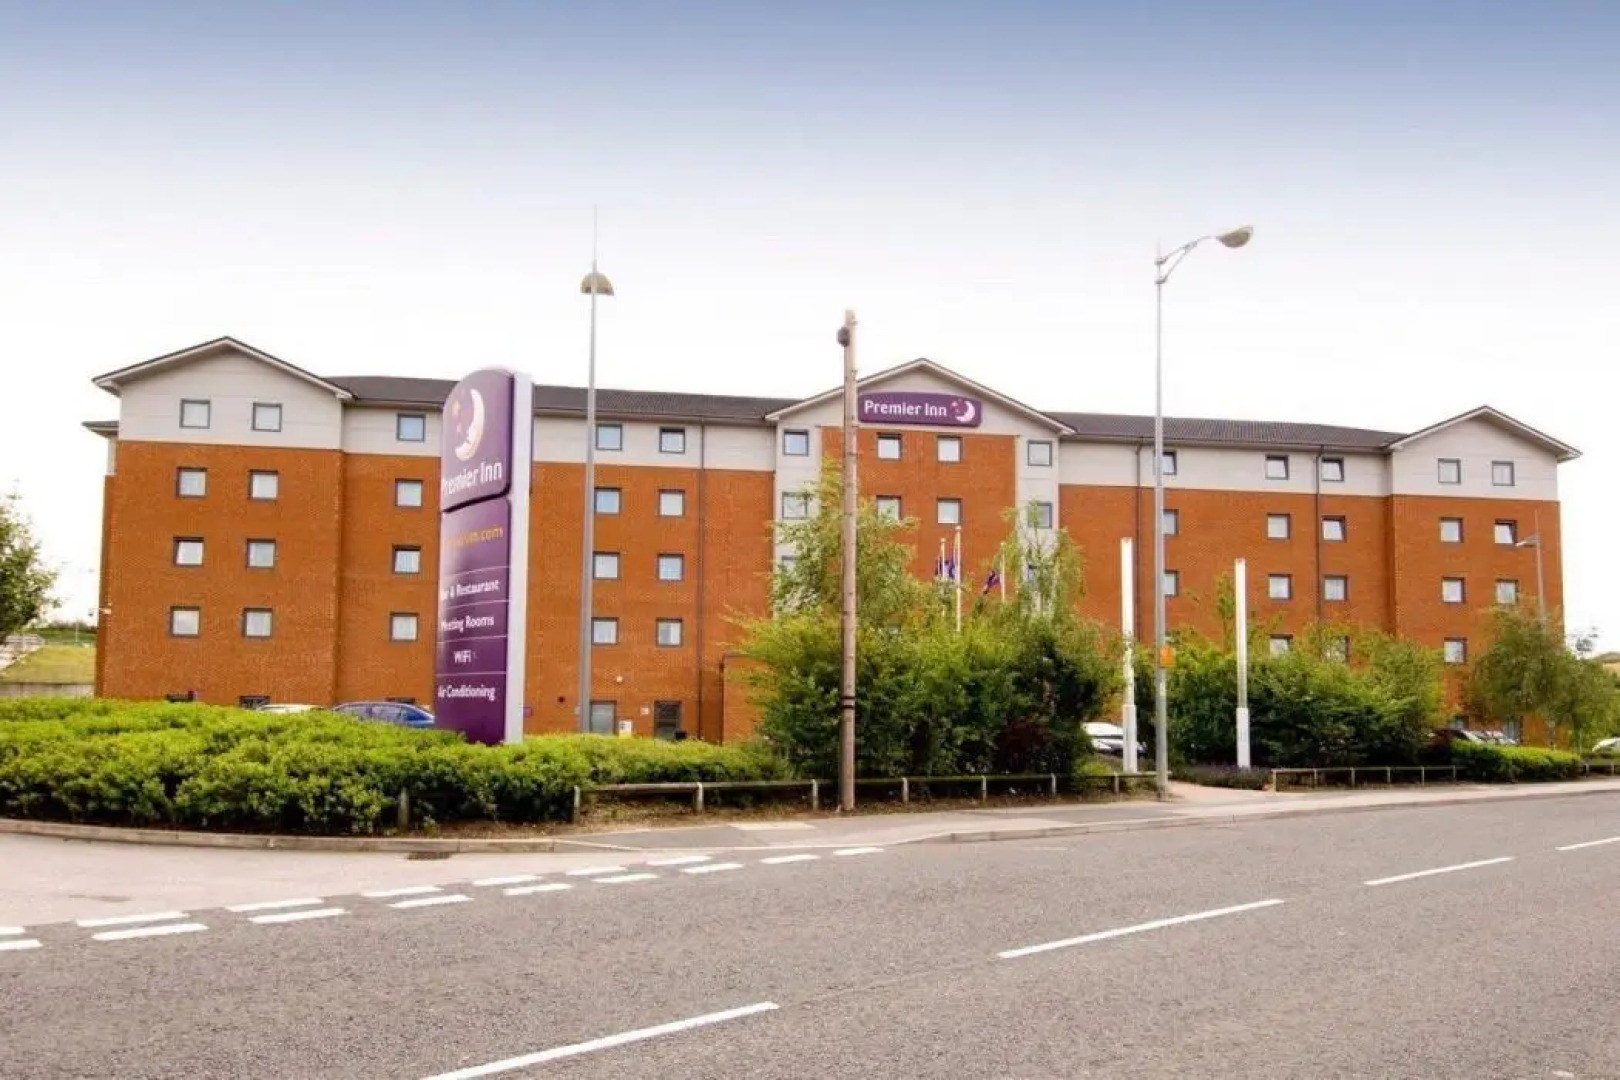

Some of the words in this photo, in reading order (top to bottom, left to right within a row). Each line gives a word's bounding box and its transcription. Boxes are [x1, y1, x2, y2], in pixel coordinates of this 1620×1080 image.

[864, 400, 922, 415] Premier
[925, 402, 947, 417] Inn
[480, 461, 502, 484] Inn
[456, 579, 499, 597] Restaurant
[465, 615, 495, 629] Rooms
[447, 684, 496, 701] Conditioning
